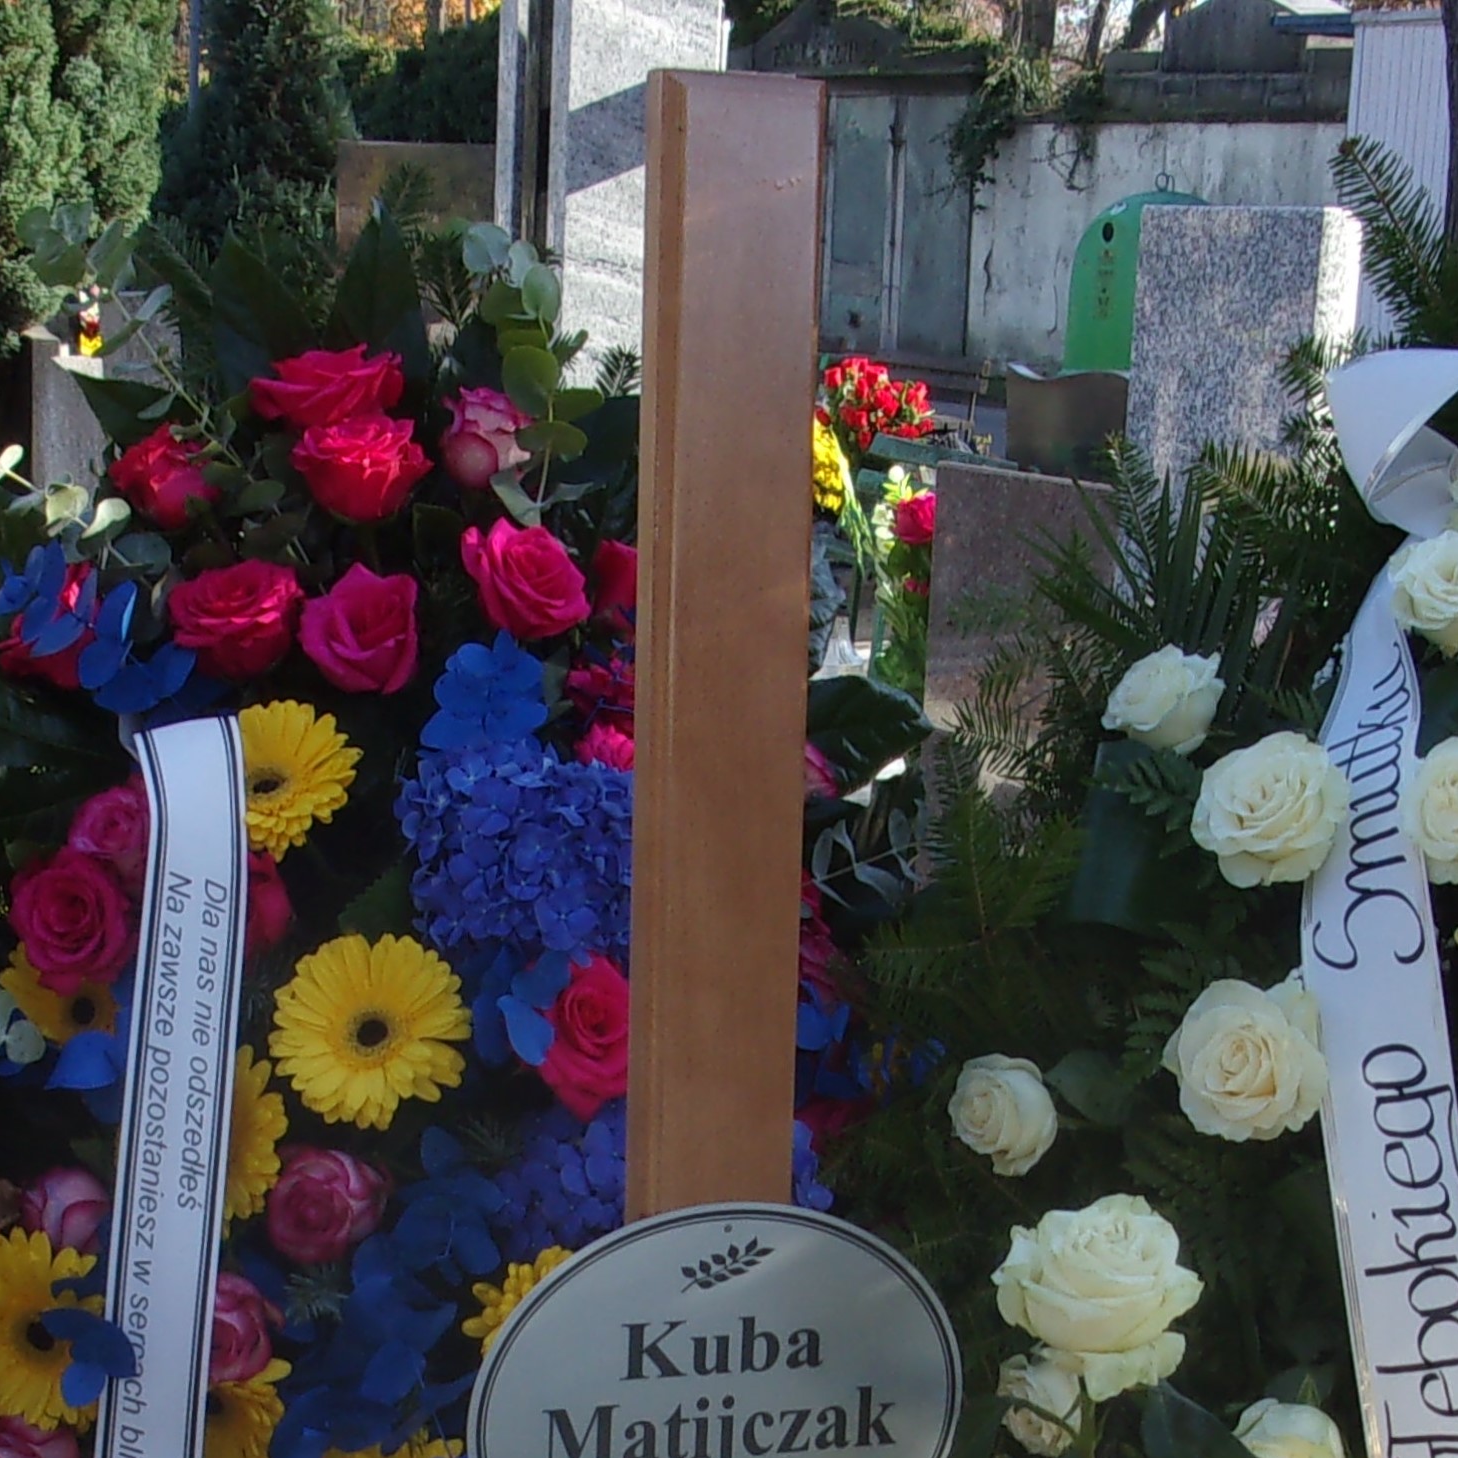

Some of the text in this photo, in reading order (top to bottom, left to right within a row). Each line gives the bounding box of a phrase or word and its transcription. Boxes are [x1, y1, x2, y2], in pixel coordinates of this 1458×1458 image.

[164, 871, 193, 917] Na
[155, 922, 184, 1036] zawsze
[176, 878, 227, 1209] Dla nas nie odszedłeś
[135, 1046, 172, 1249] pozostaniesz
[132, 1258, 151, 1285] w
[619, 1317, 824, 1381] Kuba
